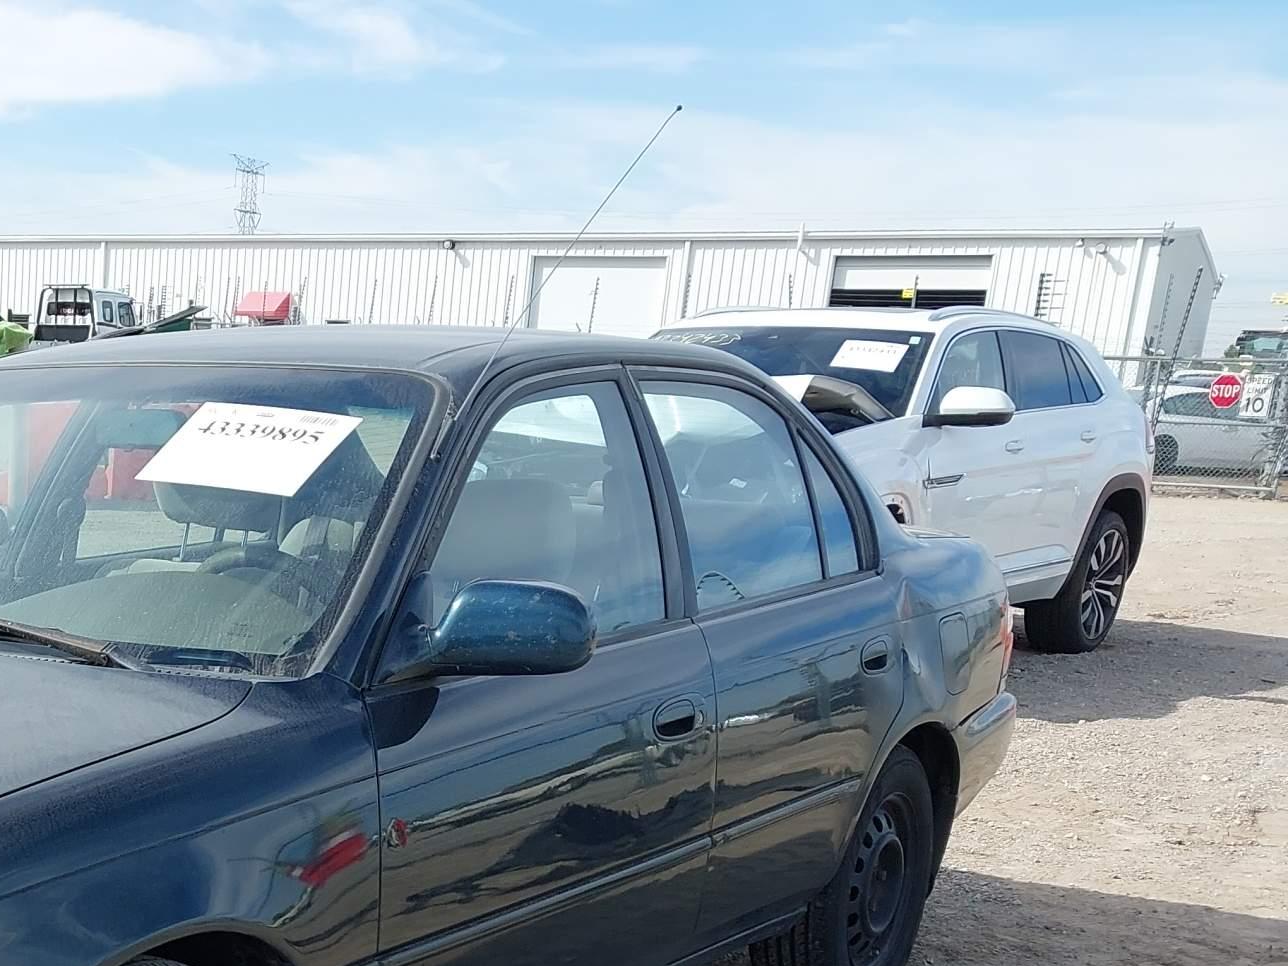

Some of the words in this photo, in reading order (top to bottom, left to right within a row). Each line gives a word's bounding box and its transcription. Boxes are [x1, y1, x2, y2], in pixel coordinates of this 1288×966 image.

[1212, 384, 1240, 398] STOP
[1244, 397, 1264, 413] 10
[198, 420, 325, 444] 43339895
